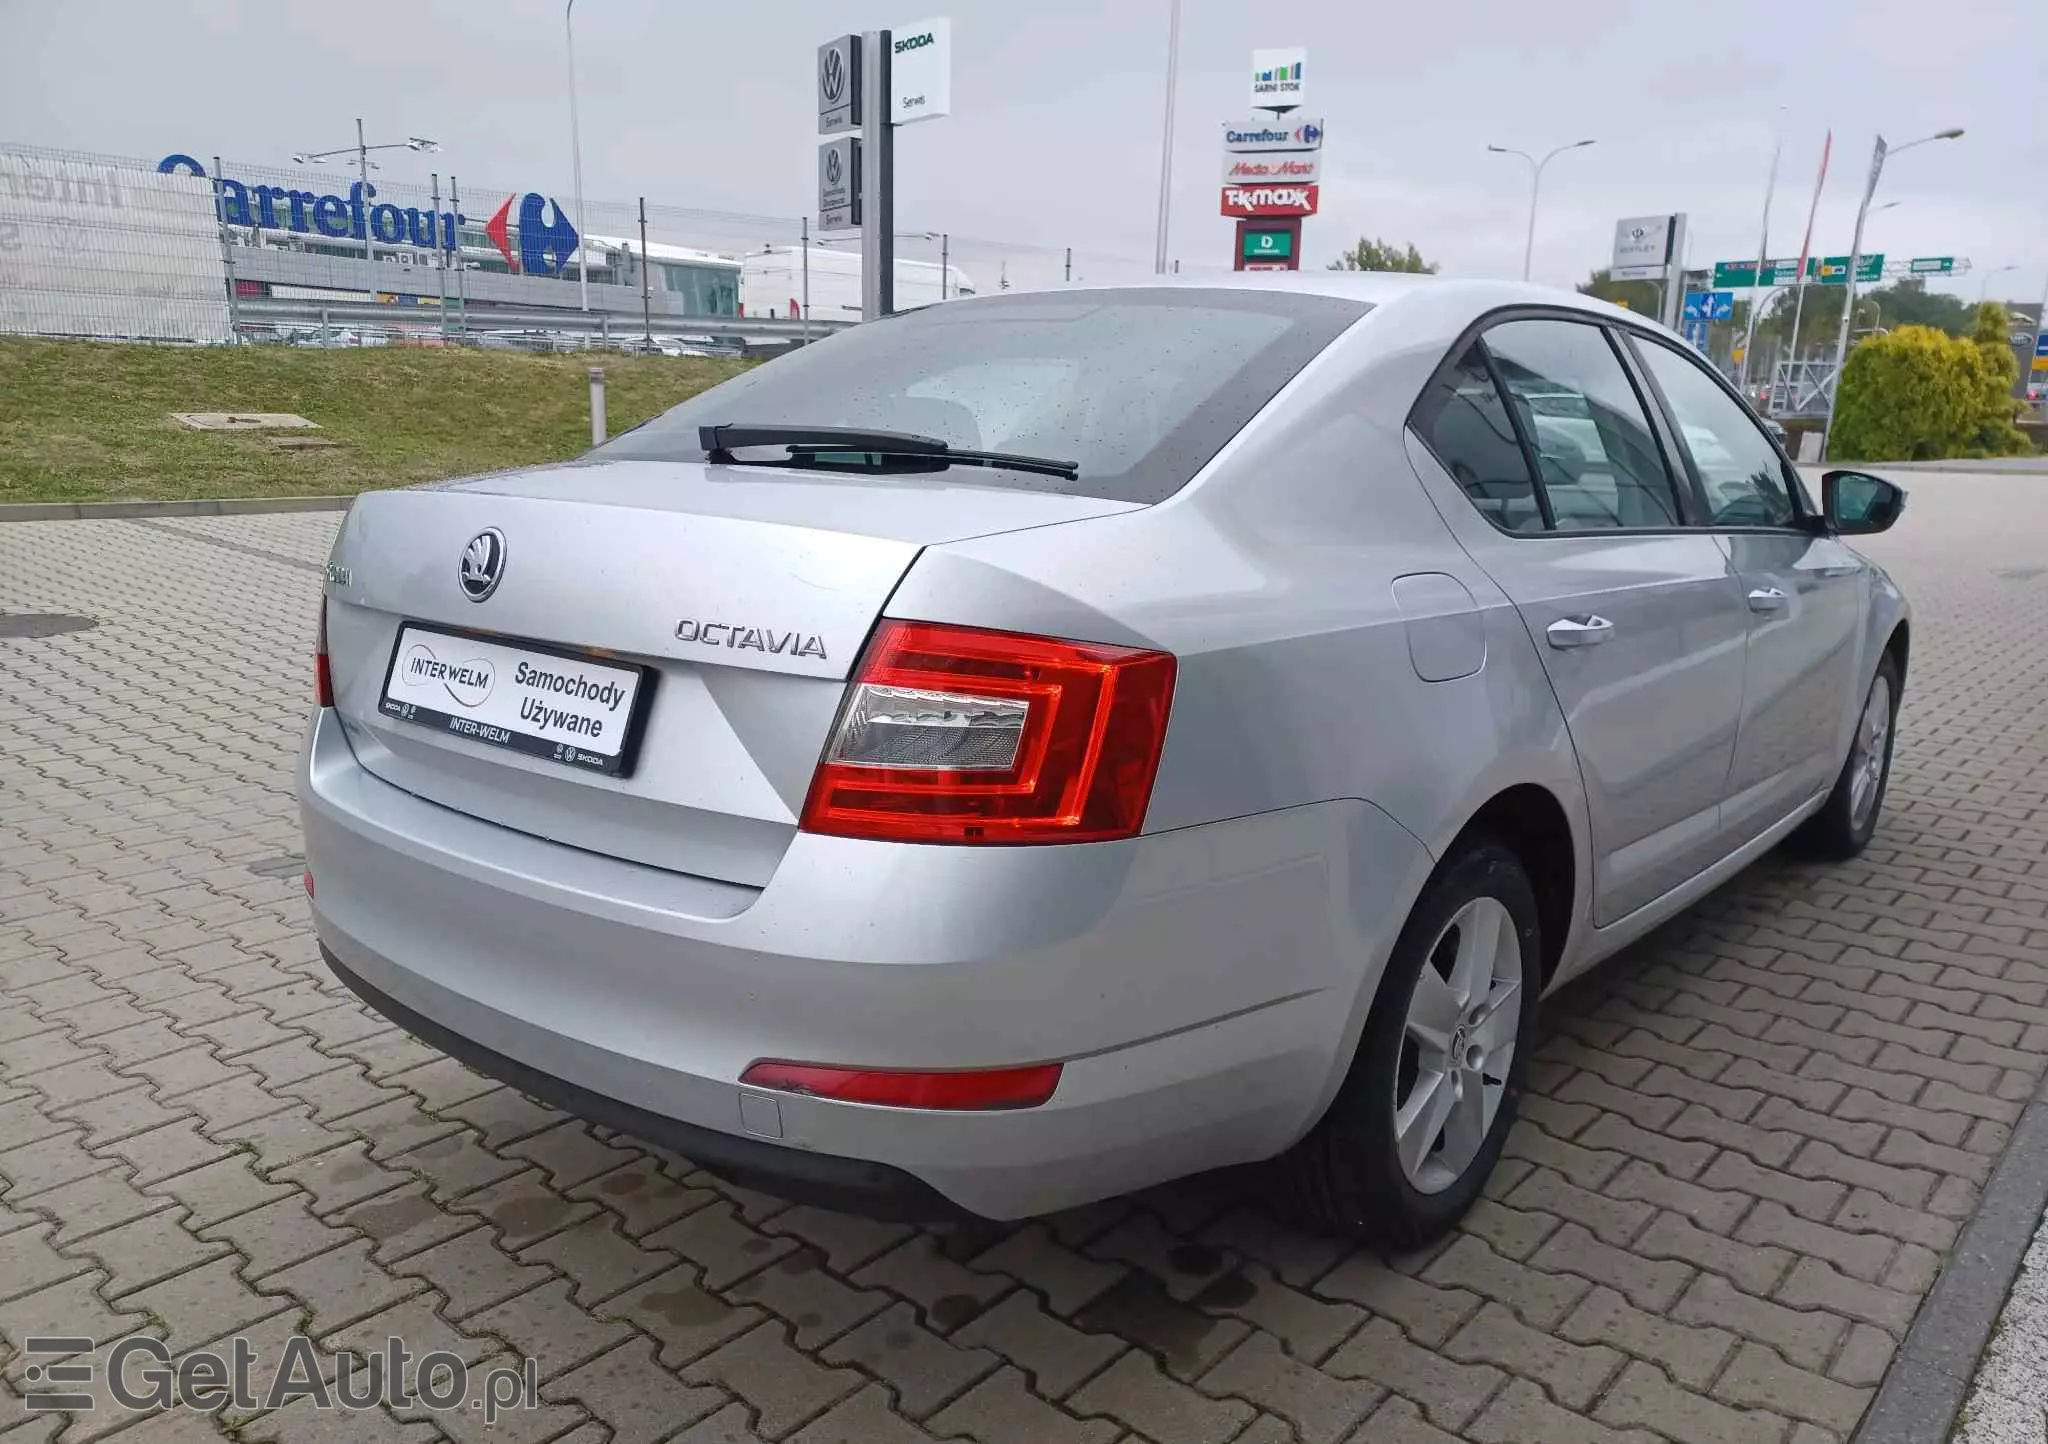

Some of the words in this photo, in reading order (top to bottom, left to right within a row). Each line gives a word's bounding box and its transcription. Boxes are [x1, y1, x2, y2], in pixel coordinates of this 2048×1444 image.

[1226, 128, 1289, 143] Carrefour
[1261, 235, 1274, 249] D
[674, 617, 828, 660] OCTAVIA
[515, 661, 626, 712] Samochody
[449, 716, 511, 744] INTER-WELM
[520, 696, 603, 738] Używane
